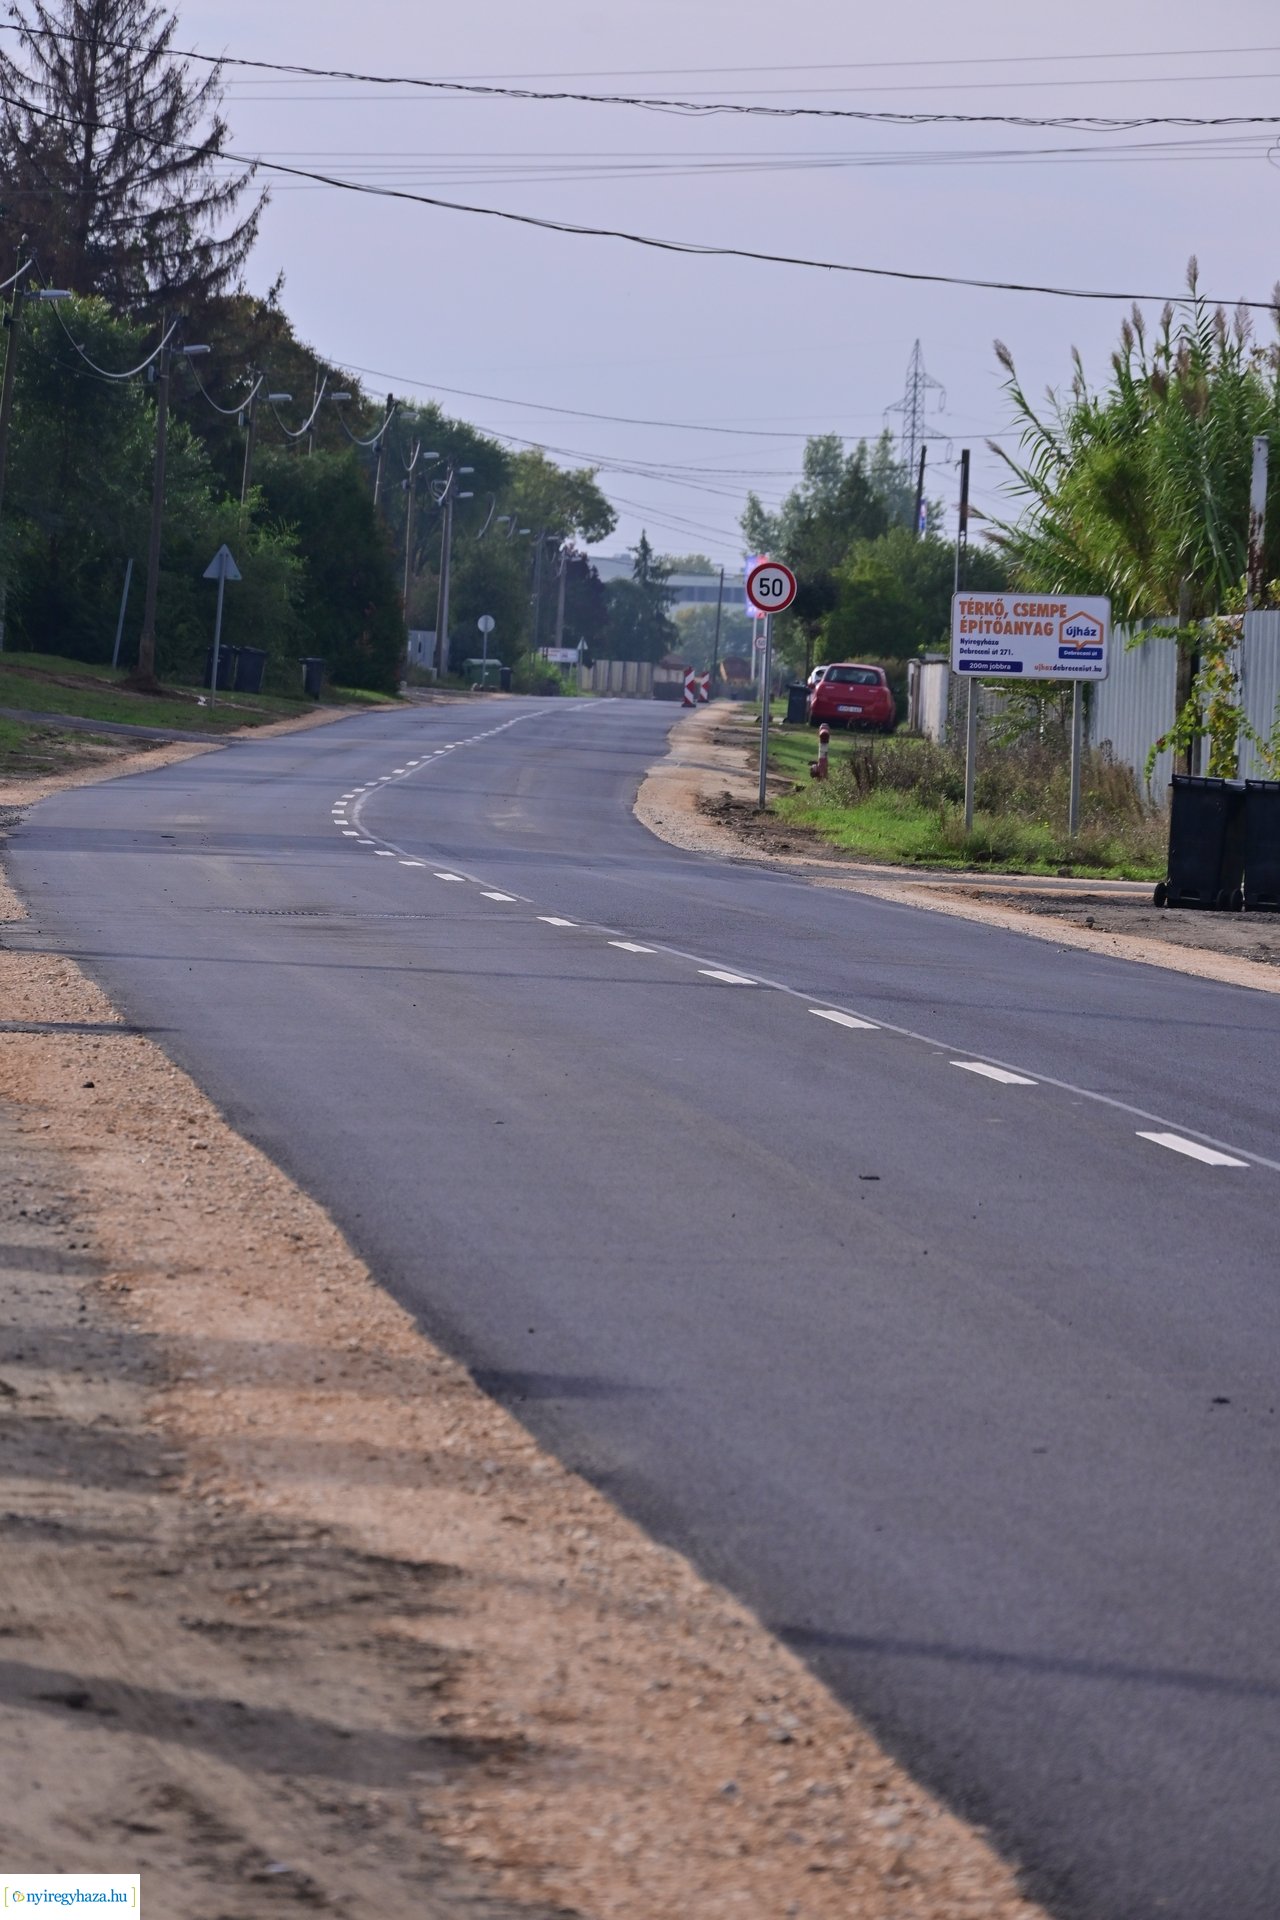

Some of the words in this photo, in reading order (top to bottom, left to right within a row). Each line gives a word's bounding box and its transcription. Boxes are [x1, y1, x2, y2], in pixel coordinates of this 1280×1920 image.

[759, 578, 783, 597] 50
[959, 597, 1009, 619] TÉRKŐ,
[1013, 602, 1067, 618] CSEMPE
[959, 616, 1054, 636] ÉPÍTŐANYAG
[1066, 626, 1097, 638] újház
[959, 647, 990, 655] Debreceni
